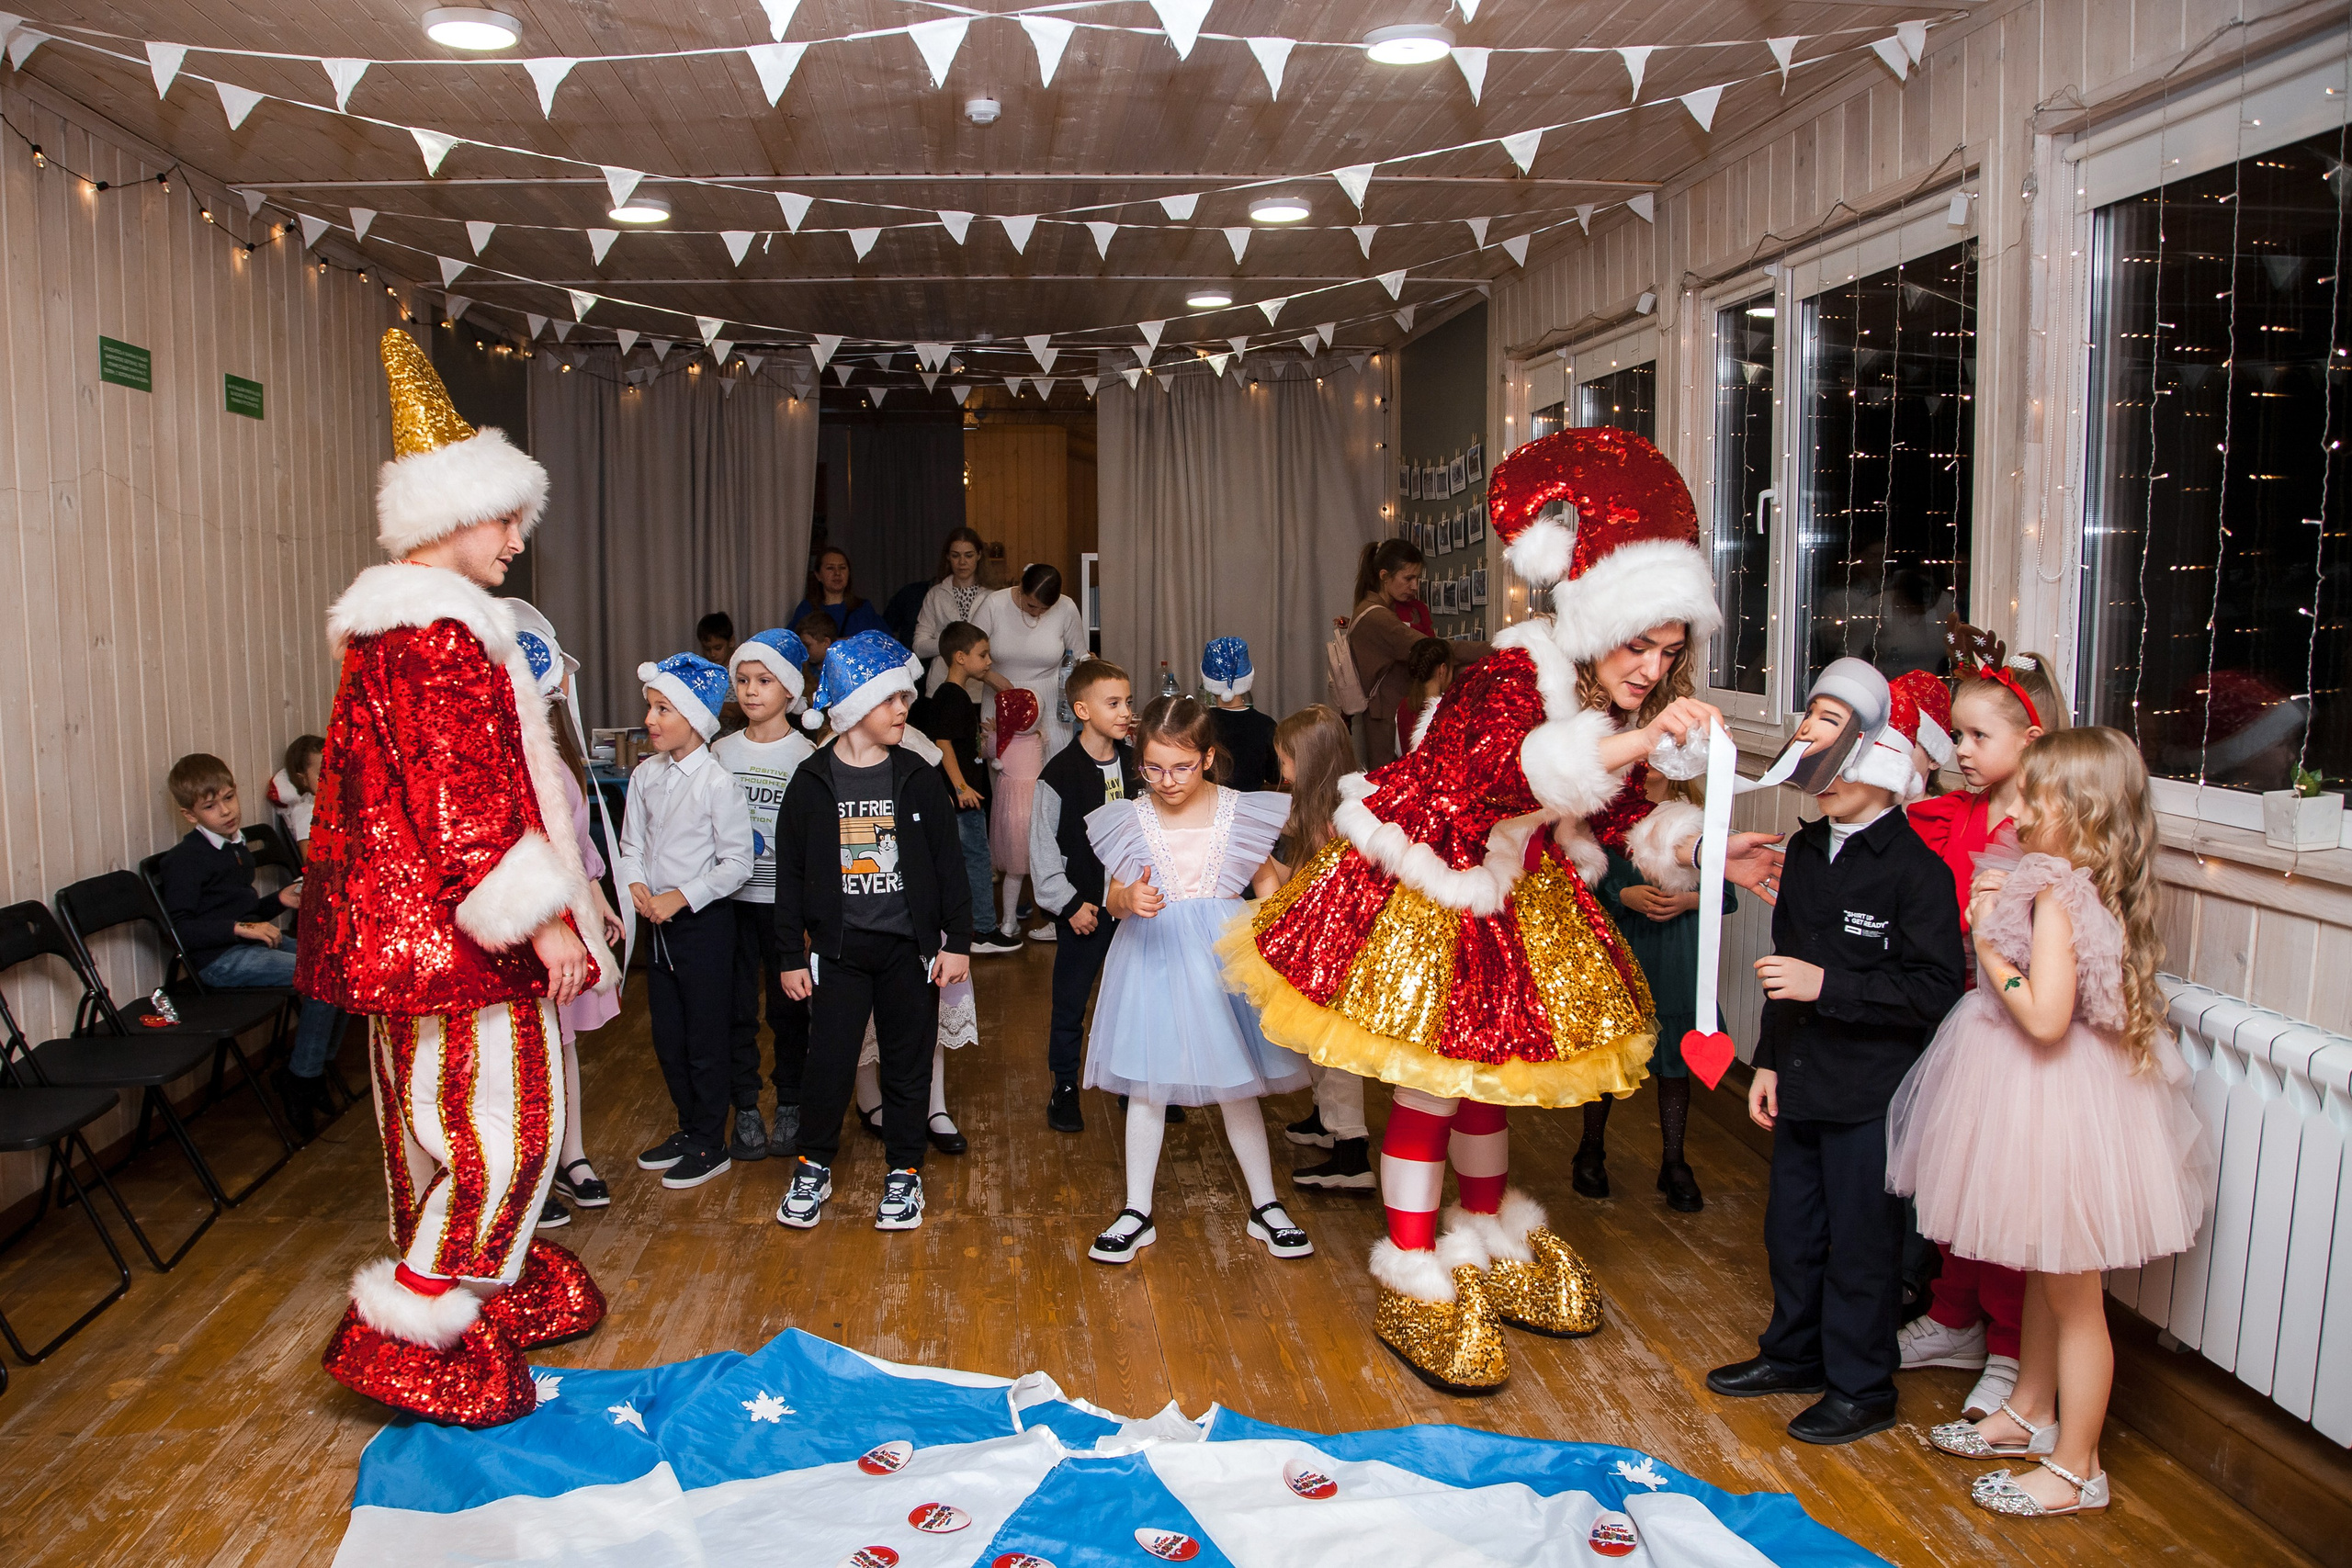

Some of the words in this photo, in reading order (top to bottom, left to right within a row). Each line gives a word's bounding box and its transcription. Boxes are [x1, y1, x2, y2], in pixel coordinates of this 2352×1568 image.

[750, 766, 788, 777] POSITIVE
[741, 777, 786, 787] THOUGHTS
[745, 786, 784, 804] UDE
[860, 799, 895, 817] FRIE
[842, 873, 899, 895] EVER
